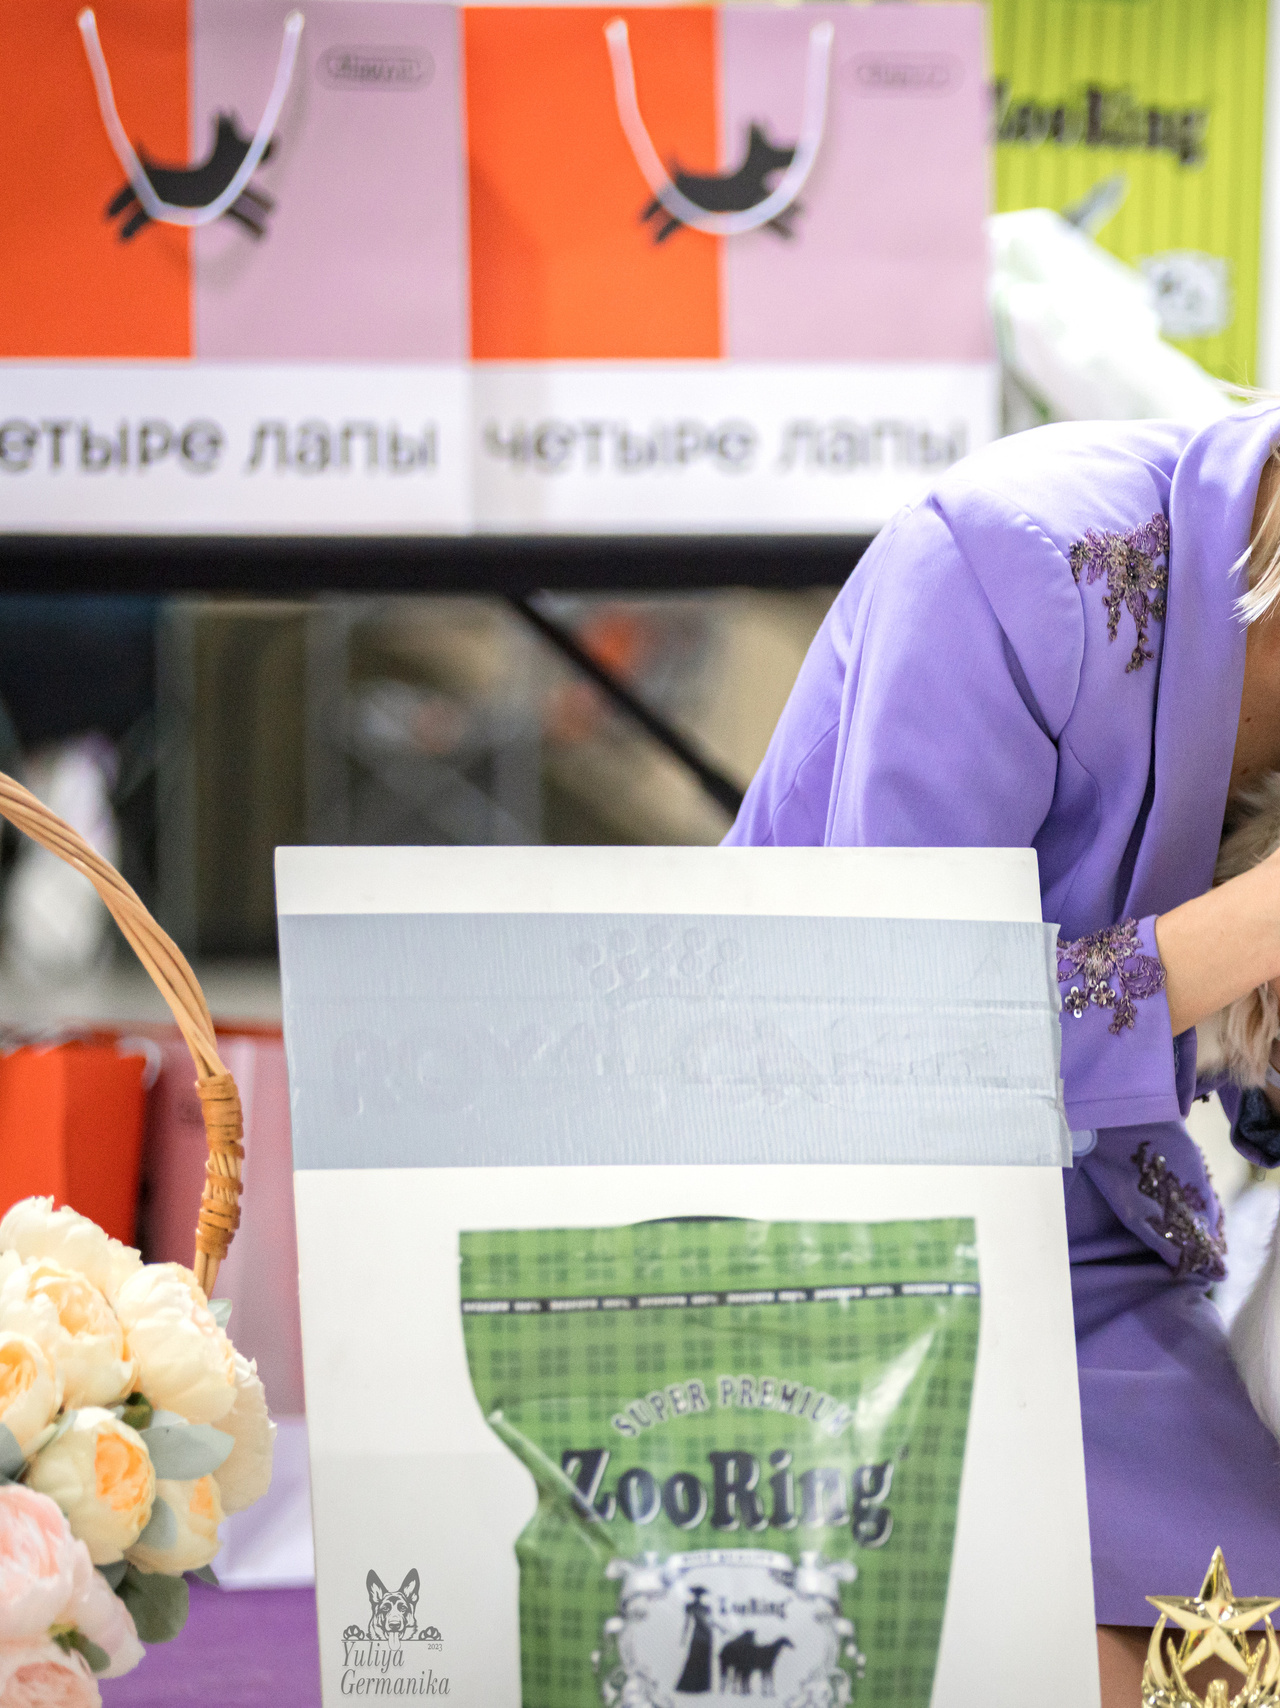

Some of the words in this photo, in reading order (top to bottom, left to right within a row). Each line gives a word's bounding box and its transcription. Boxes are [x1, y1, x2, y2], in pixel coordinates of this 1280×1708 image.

[245, 417, 439, 474] лапы
[483, 417, 756, 474] четыре
[776, 416, 967, 474] лапы
[613, 1380, 708, 1437] SUPER
[561, 1448, 894, 1548] ZooRing
